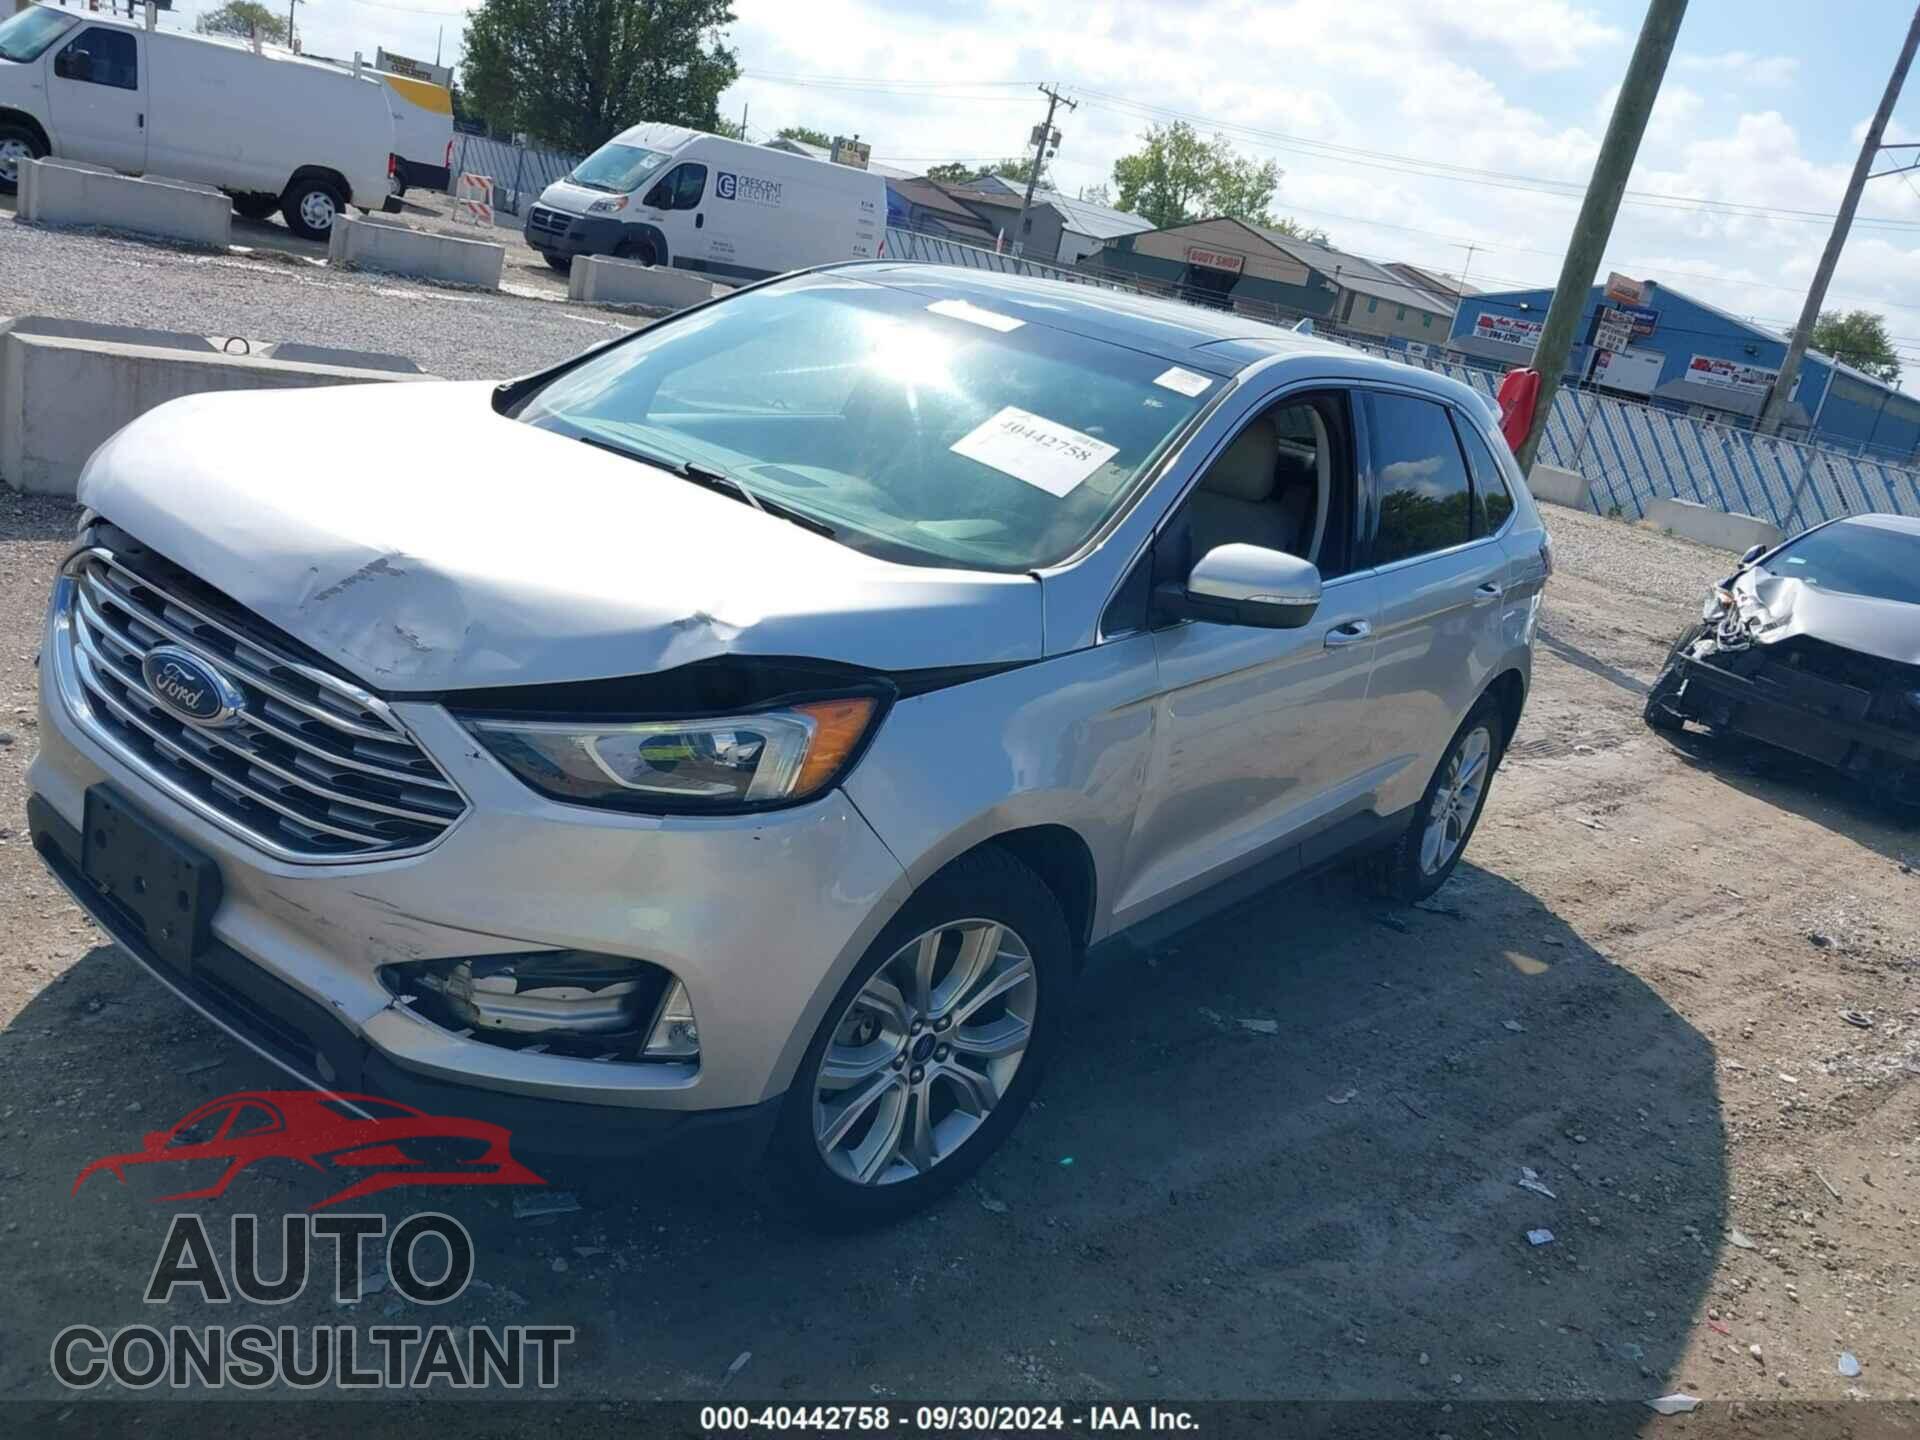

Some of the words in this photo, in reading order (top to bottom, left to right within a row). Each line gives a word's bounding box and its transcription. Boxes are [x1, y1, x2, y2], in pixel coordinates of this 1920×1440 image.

[739, 175, 783, 193] CRESCENT
[739, 187, 782, 203] ELECTRIC
[1216, 255, 1241, 270] SHOP
[156, 662, 204, 709] Ford
